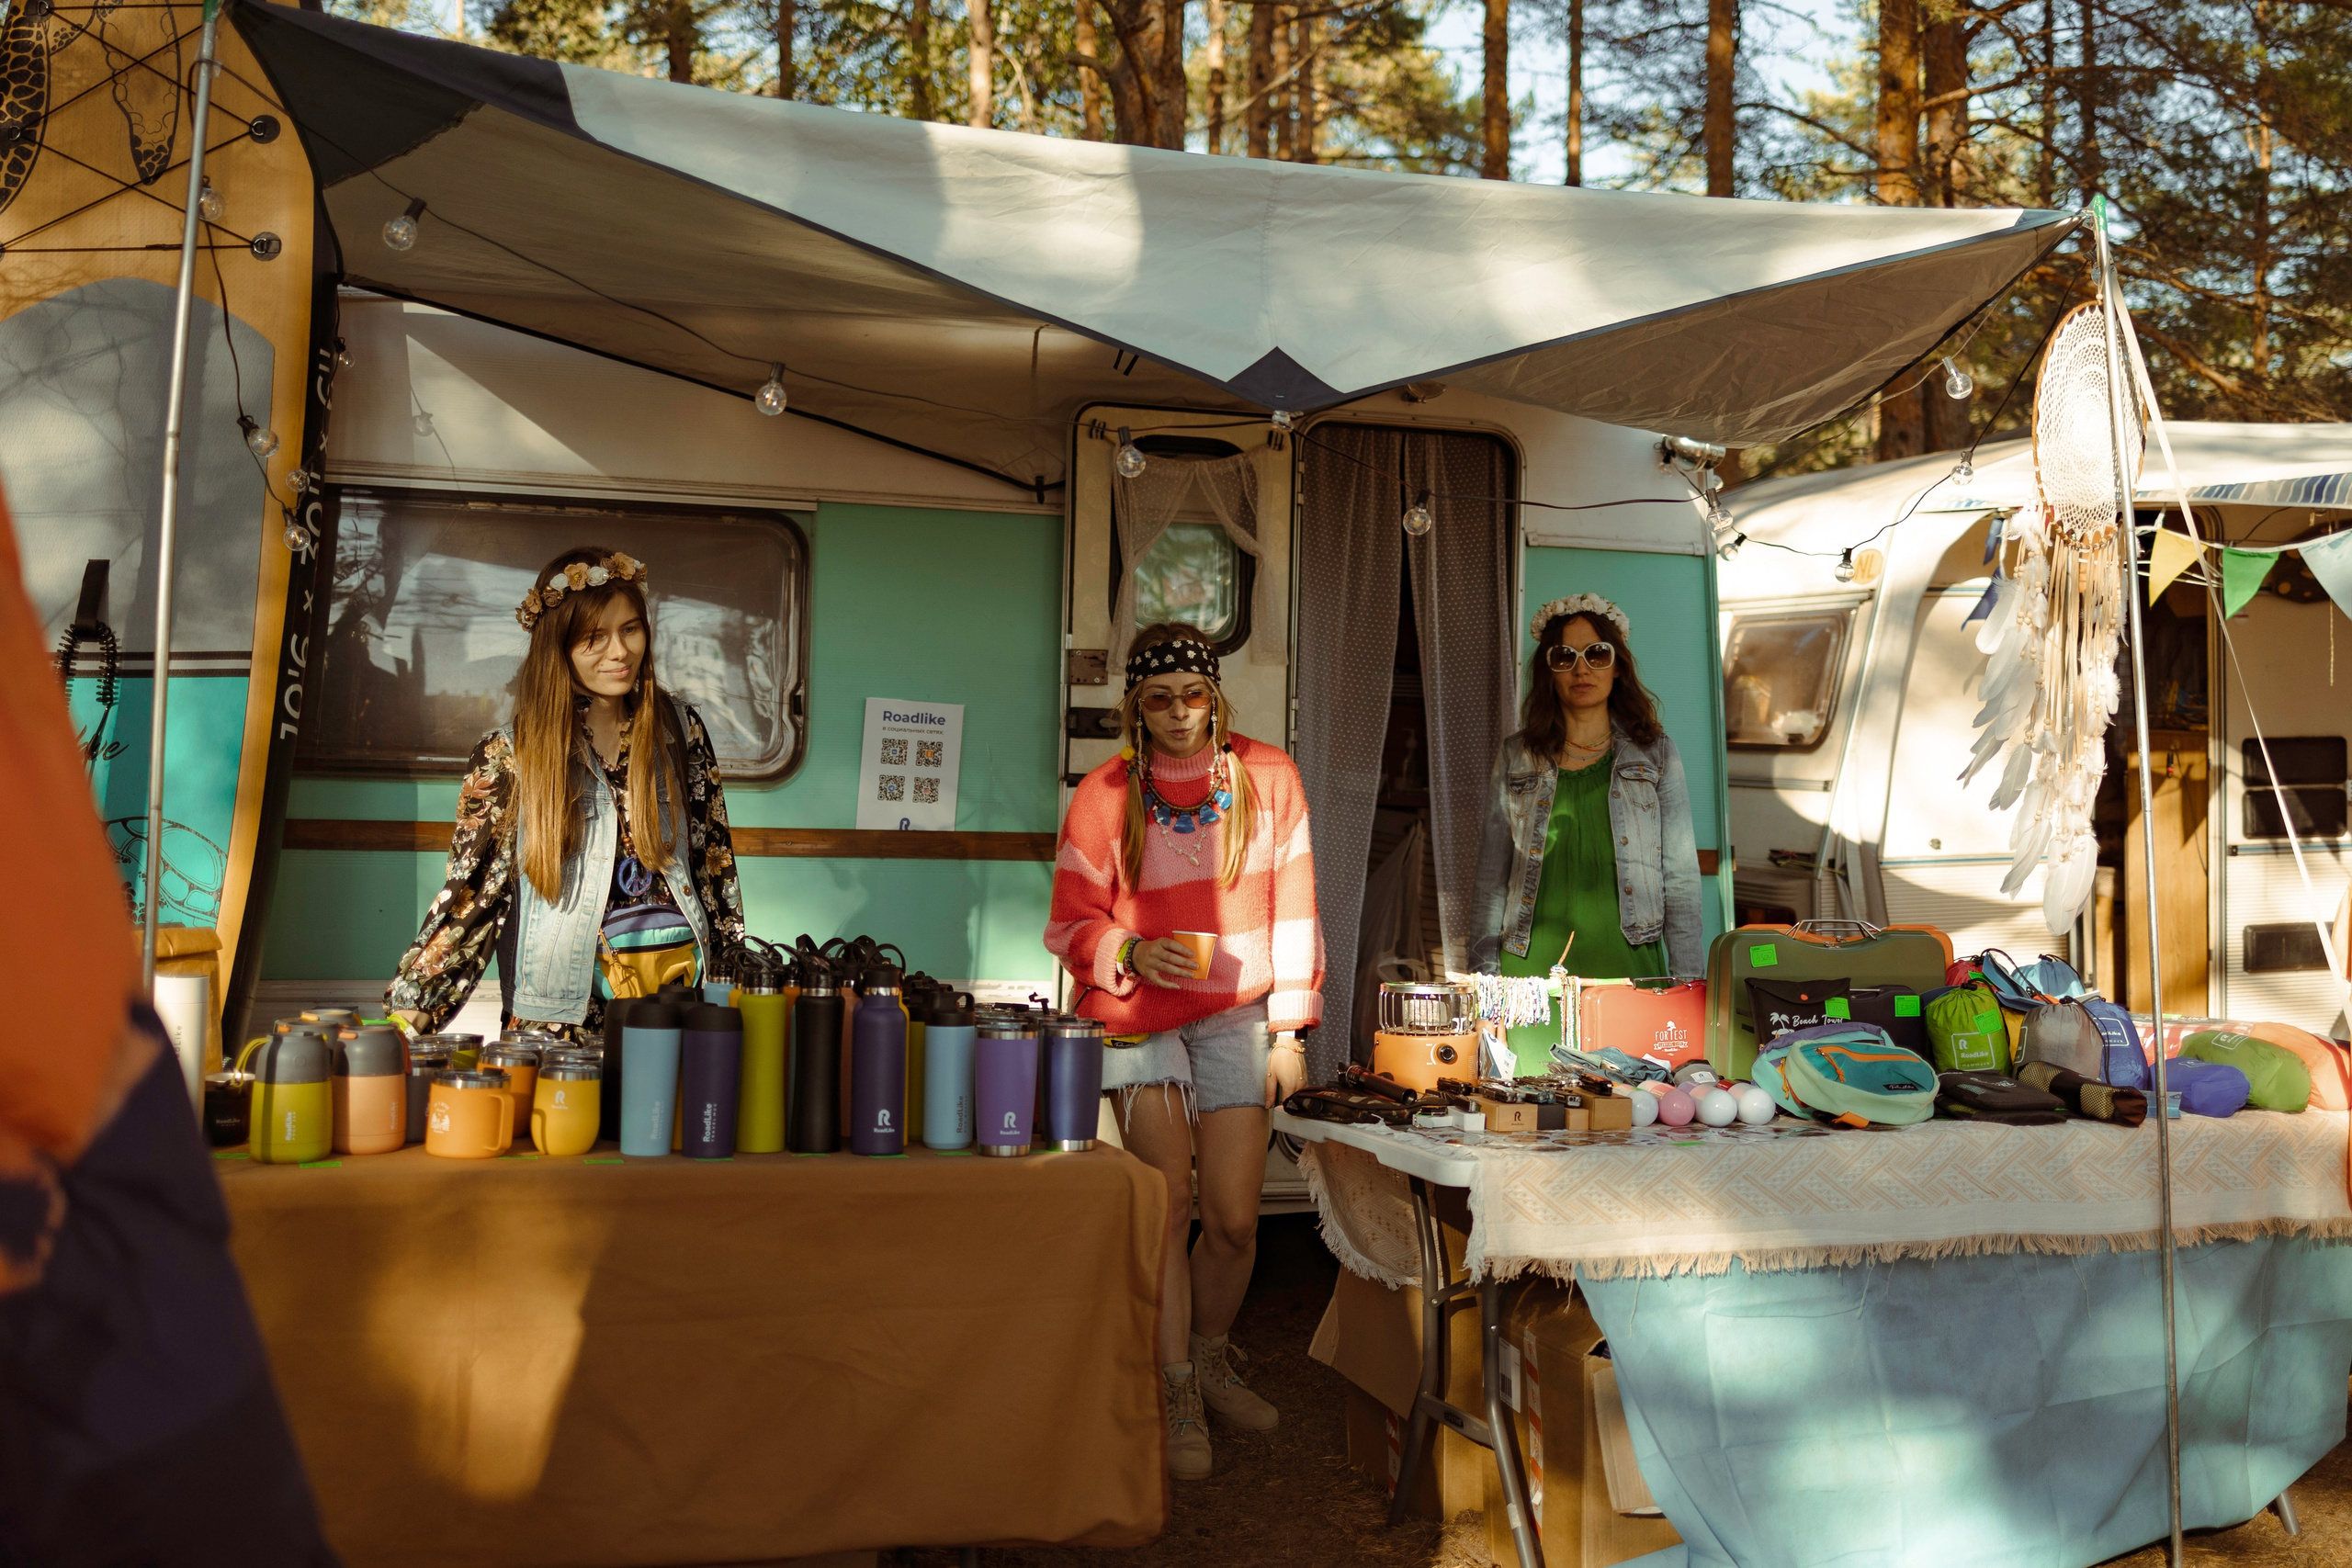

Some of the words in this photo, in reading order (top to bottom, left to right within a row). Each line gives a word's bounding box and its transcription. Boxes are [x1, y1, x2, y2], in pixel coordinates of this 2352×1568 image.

[883, 710, 946, 726] Roadlike
[1792, 1015, 1818, 1027] Beach
[1959, 1039, 1968, 1050] R
[1961, 1051, 1989, 1059] RoadLike
[555, 1089, 566, 1104] R
[877, 1109, 891, 1126] R
[956, 1095, 965, 1134] RoadLike
[1003, 1111, 1017, 1129] R
[1513, 1111, 1521, 1122] R
[702, 1103, 713, 1143] RoadLike
